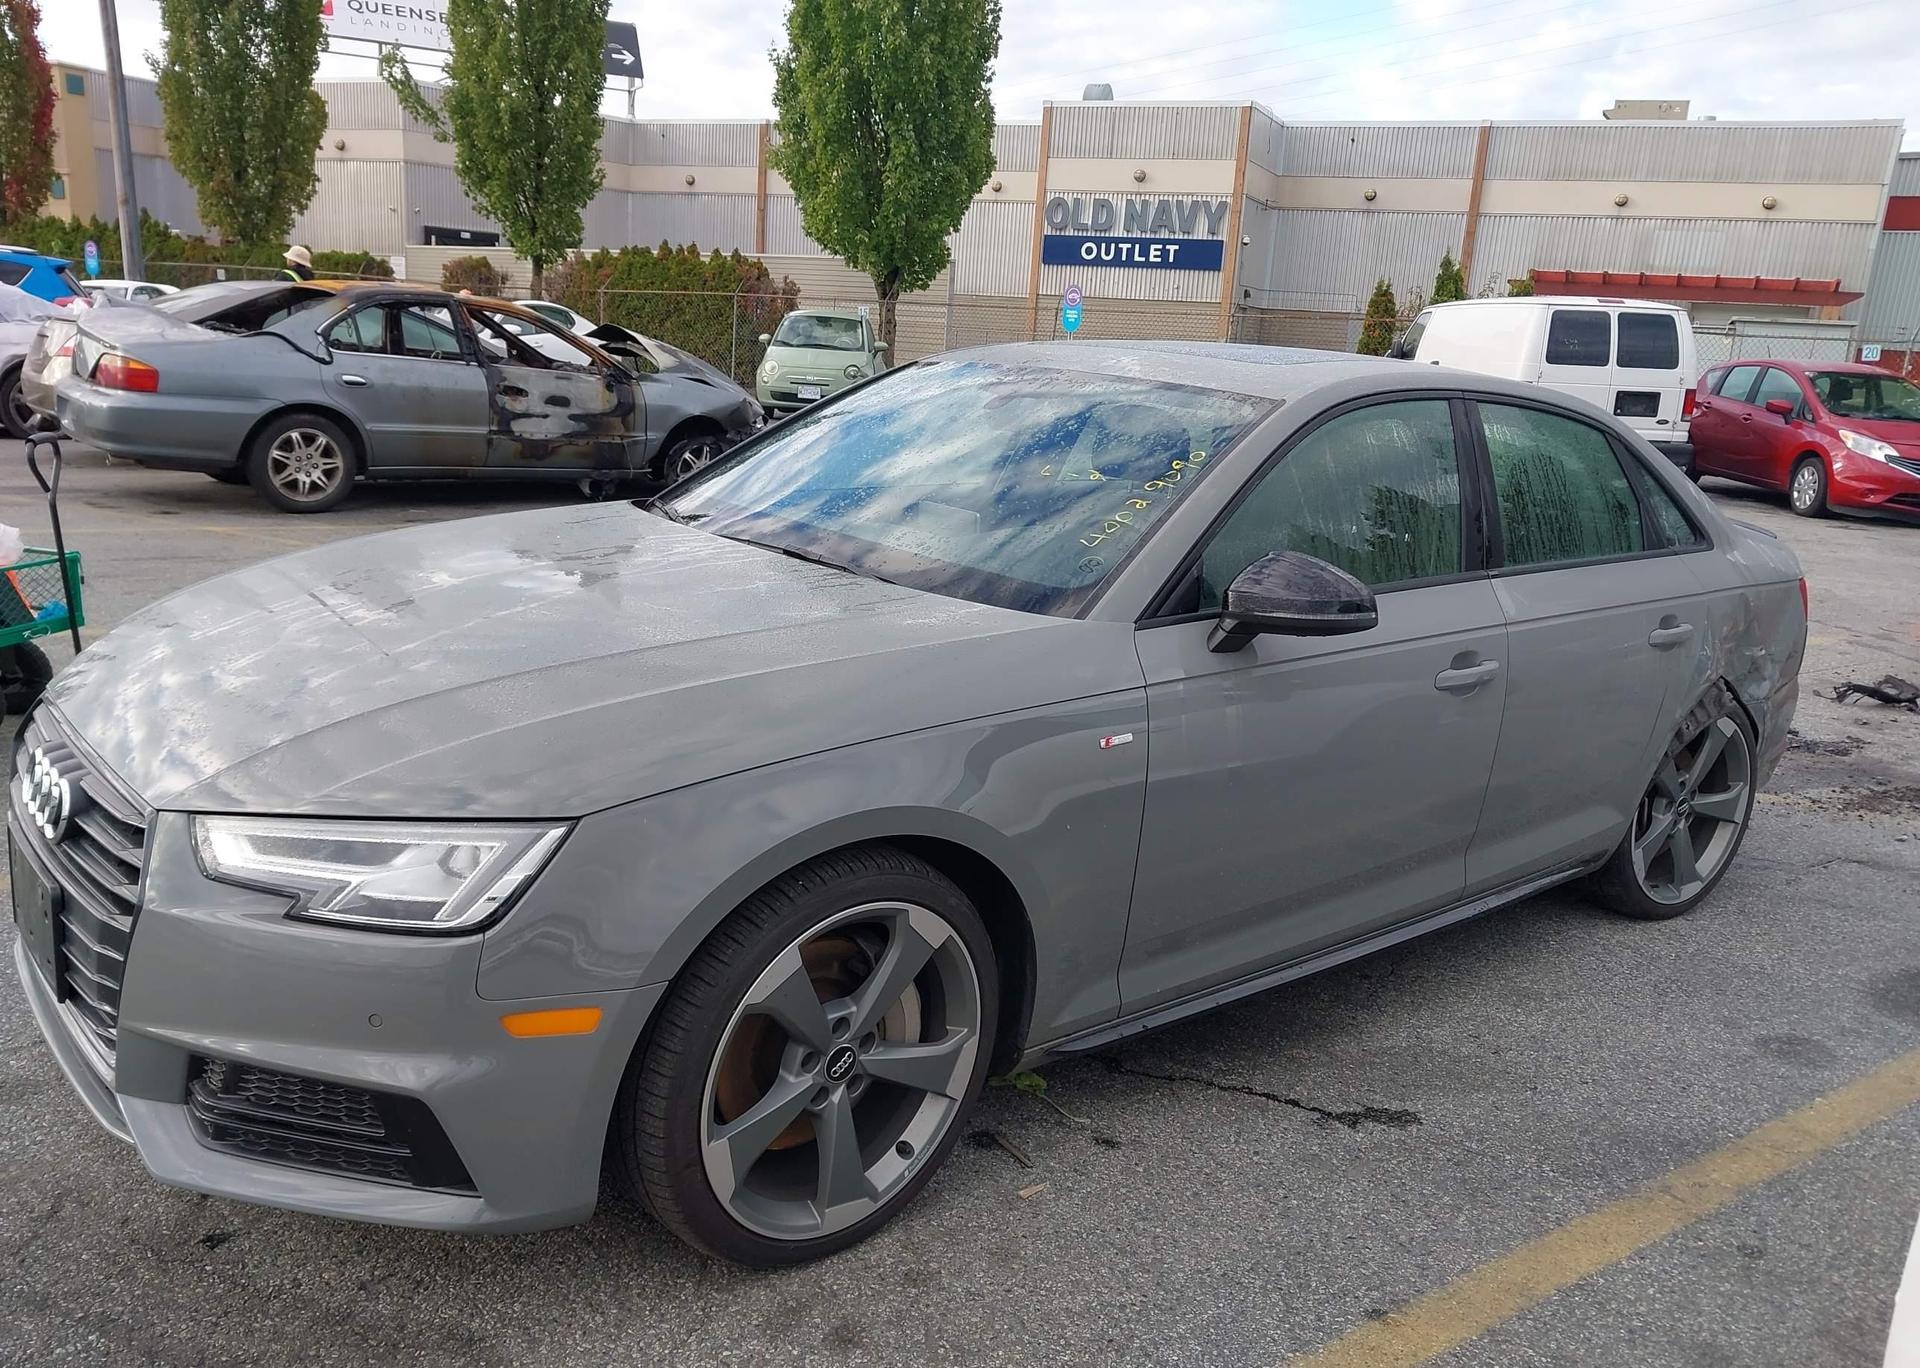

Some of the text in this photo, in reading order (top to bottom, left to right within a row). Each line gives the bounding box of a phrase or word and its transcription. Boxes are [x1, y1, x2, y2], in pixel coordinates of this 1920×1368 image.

[1045, 197, 1228, 234] OLD NAVY
[1080, 242, 1180, 263] OUTLET
[1864, 347, 1878, 358] 20
